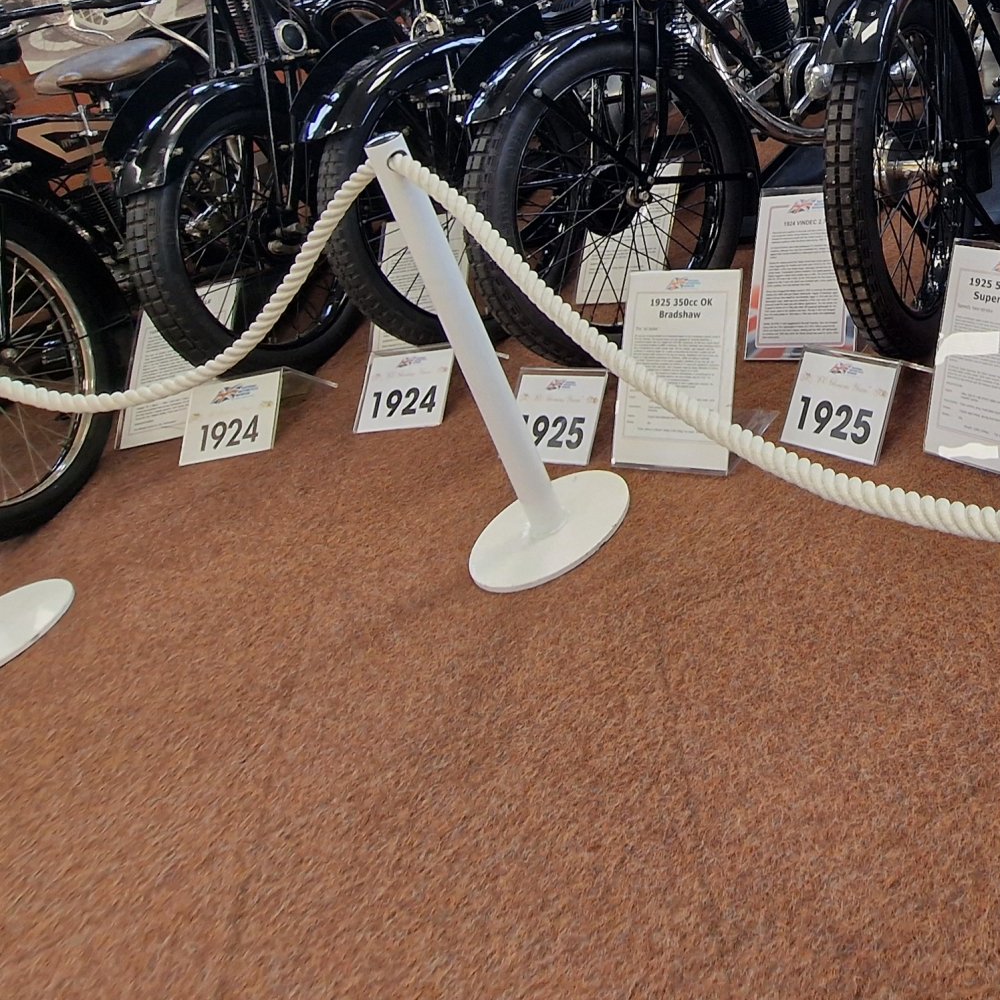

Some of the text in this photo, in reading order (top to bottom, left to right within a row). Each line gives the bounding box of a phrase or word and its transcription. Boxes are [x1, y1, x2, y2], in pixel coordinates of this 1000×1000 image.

[969, 277, 992, 289] 1925
[650, 297, 713, 307] 1925 350cc OK
[973, 291, 1000, 304] Super
[659, 310, 701, 319] Bradshaw
[372, 385, 437, 419] 1924
[798, 395, 874, 445] 1925
[200, 414, 259, 452] 1924
